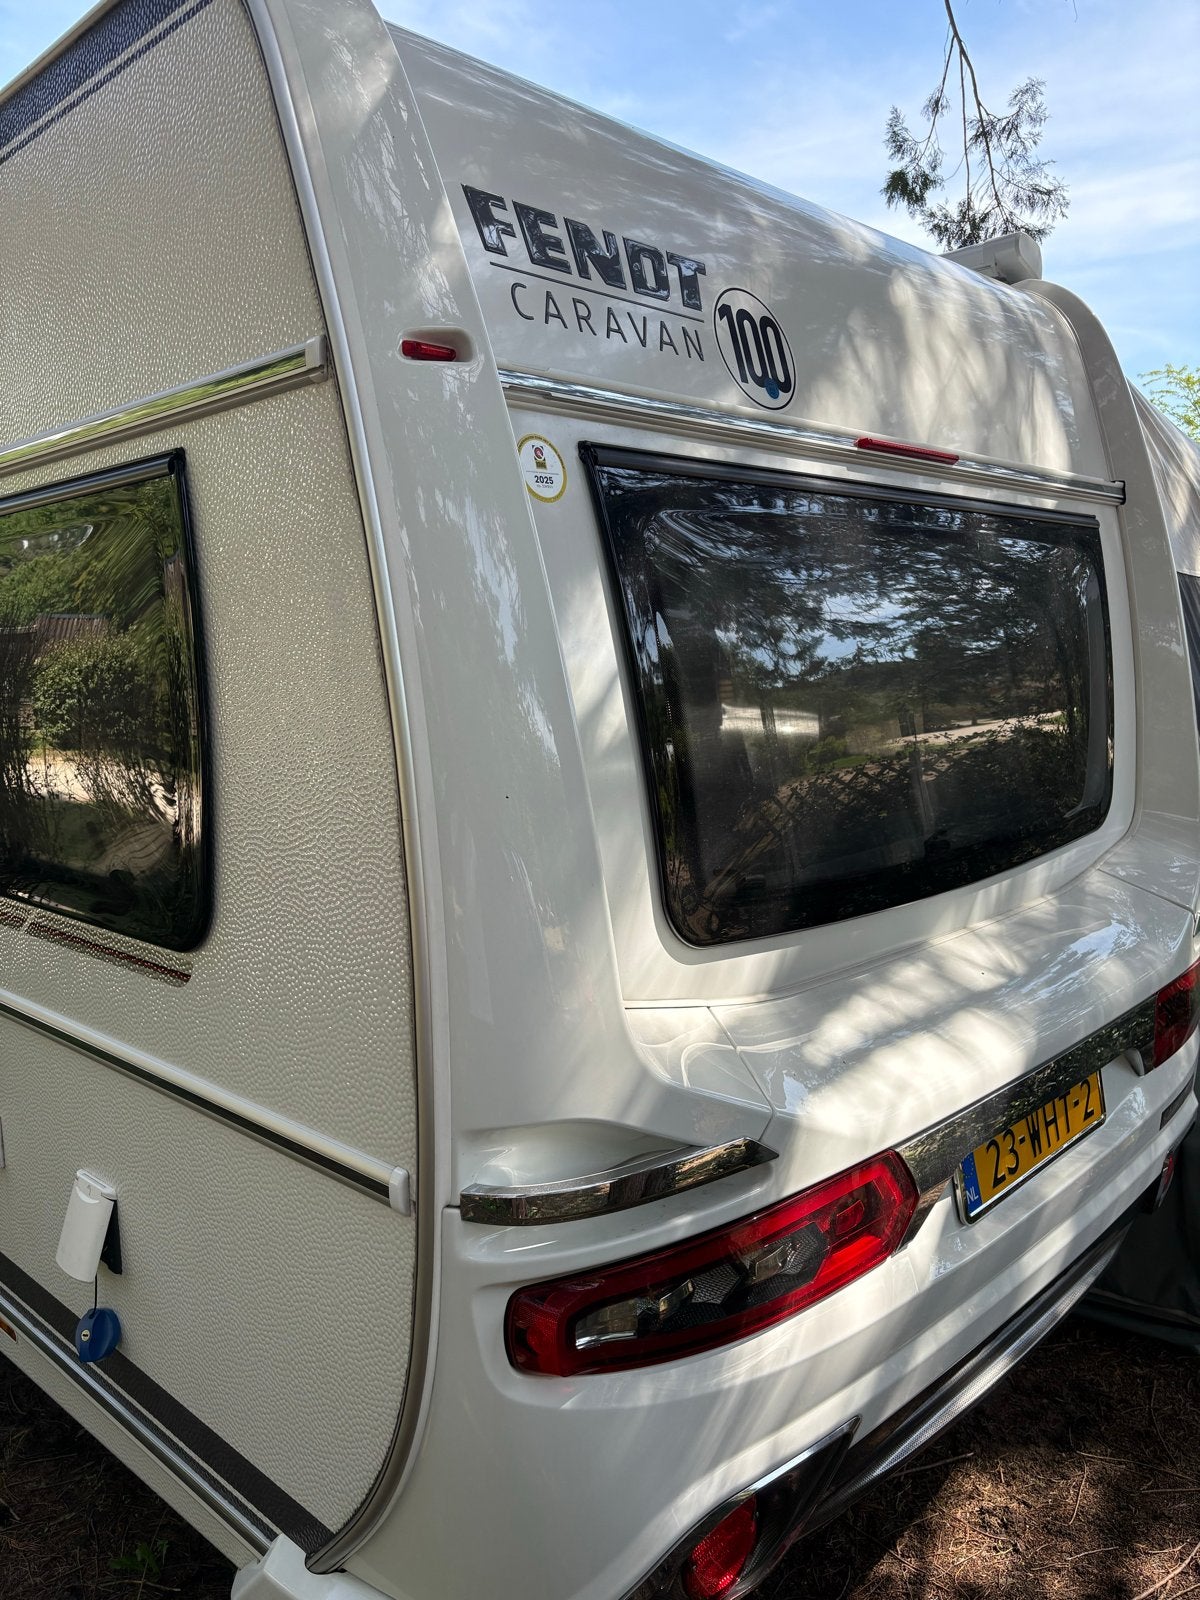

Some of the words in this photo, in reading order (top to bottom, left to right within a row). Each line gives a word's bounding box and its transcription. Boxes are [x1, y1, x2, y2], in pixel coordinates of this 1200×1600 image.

[461, 184, 707, 312] FENDT
[510, 282, 705, 362] CARAVAN
[717, 303, 792, 394] 100
[534, 475, 554, 485] 2025
[986, 1078, 1095, 1190] 23-WHT-2
[966, 1186, 979, 1204] NL
